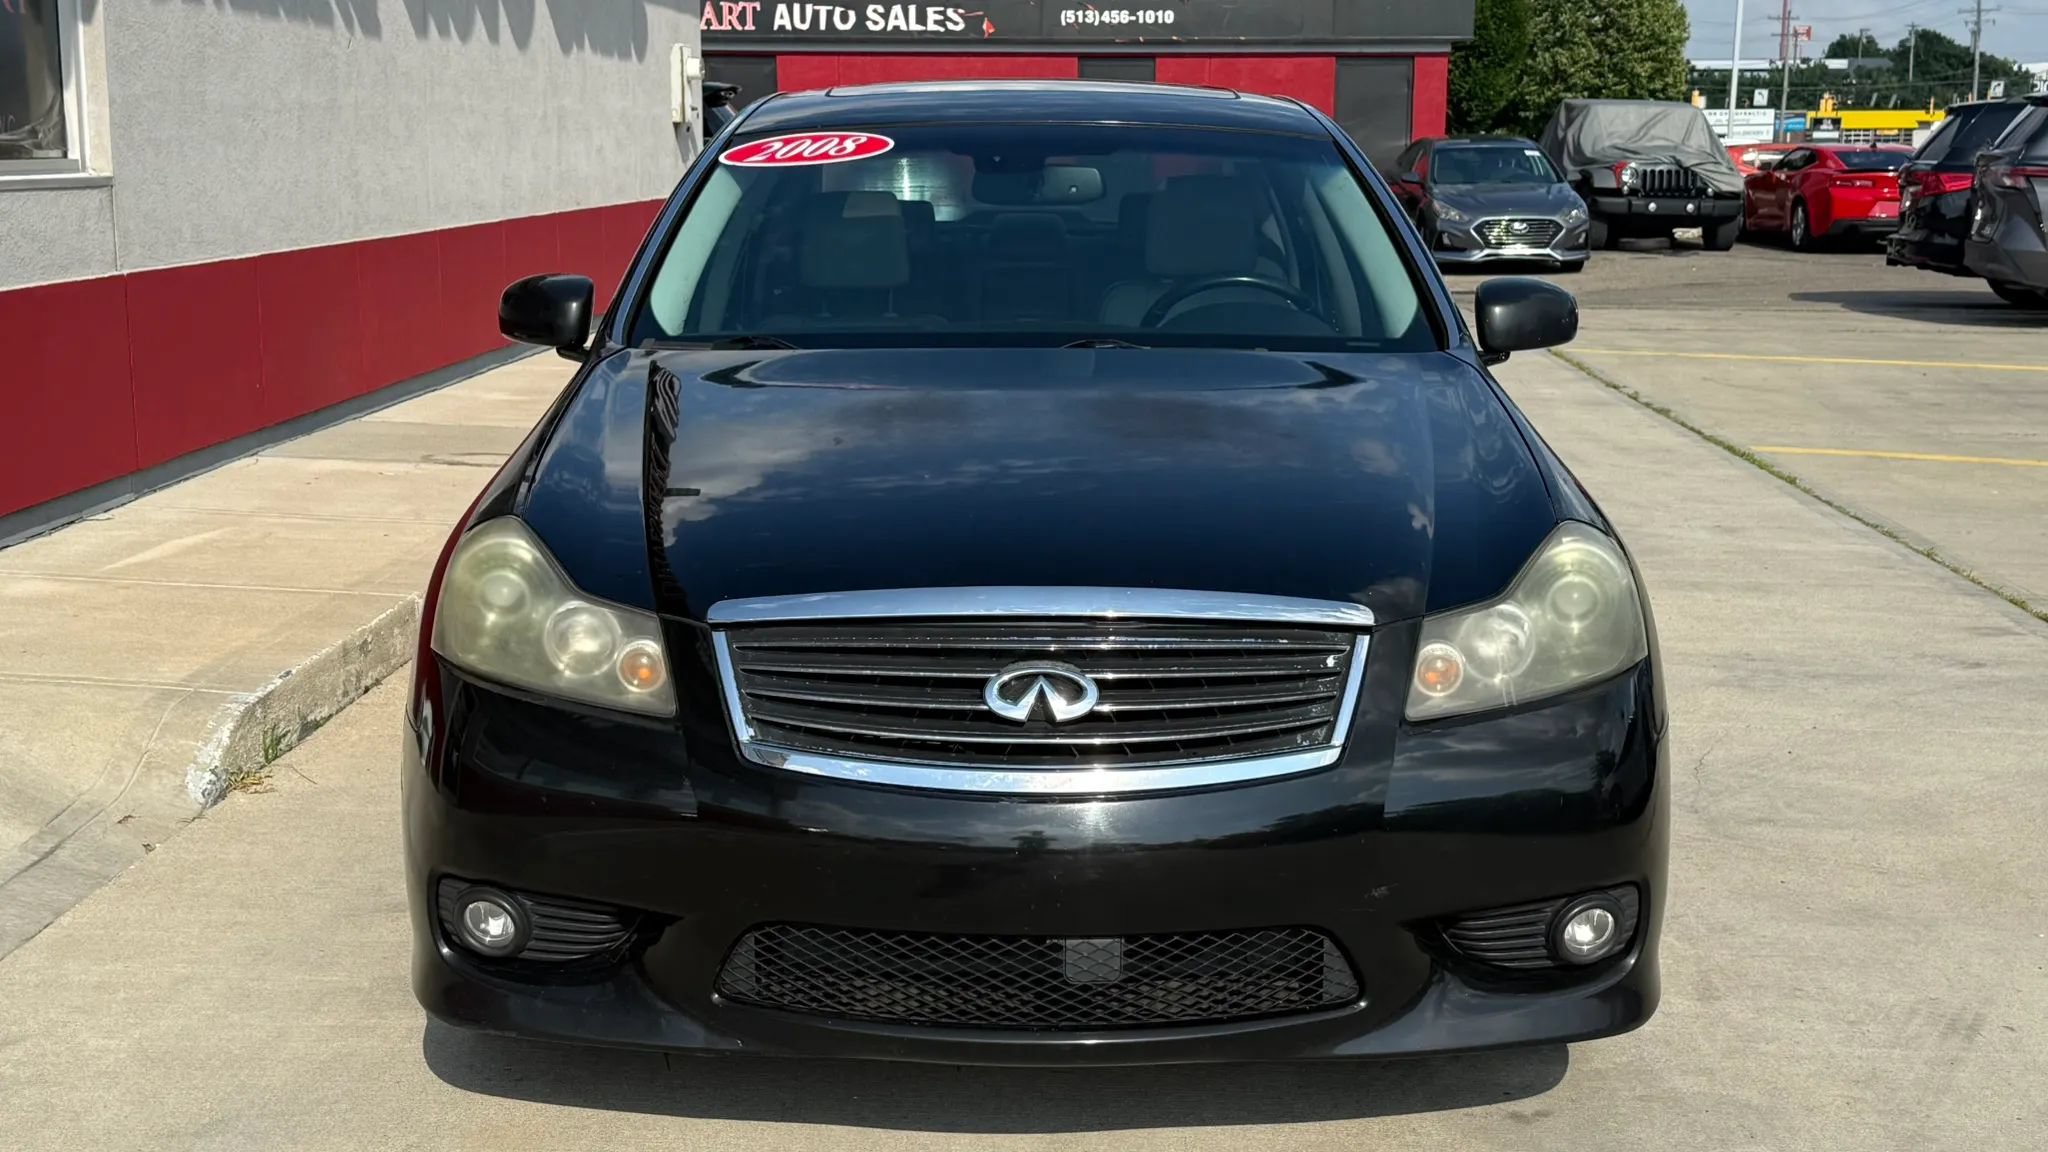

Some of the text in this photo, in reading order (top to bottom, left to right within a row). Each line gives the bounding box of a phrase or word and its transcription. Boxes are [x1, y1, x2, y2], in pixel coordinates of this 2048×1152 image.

[700, 1, 966, 32] ART AUTO SALES
[742, 136, 868, 162] 2008
